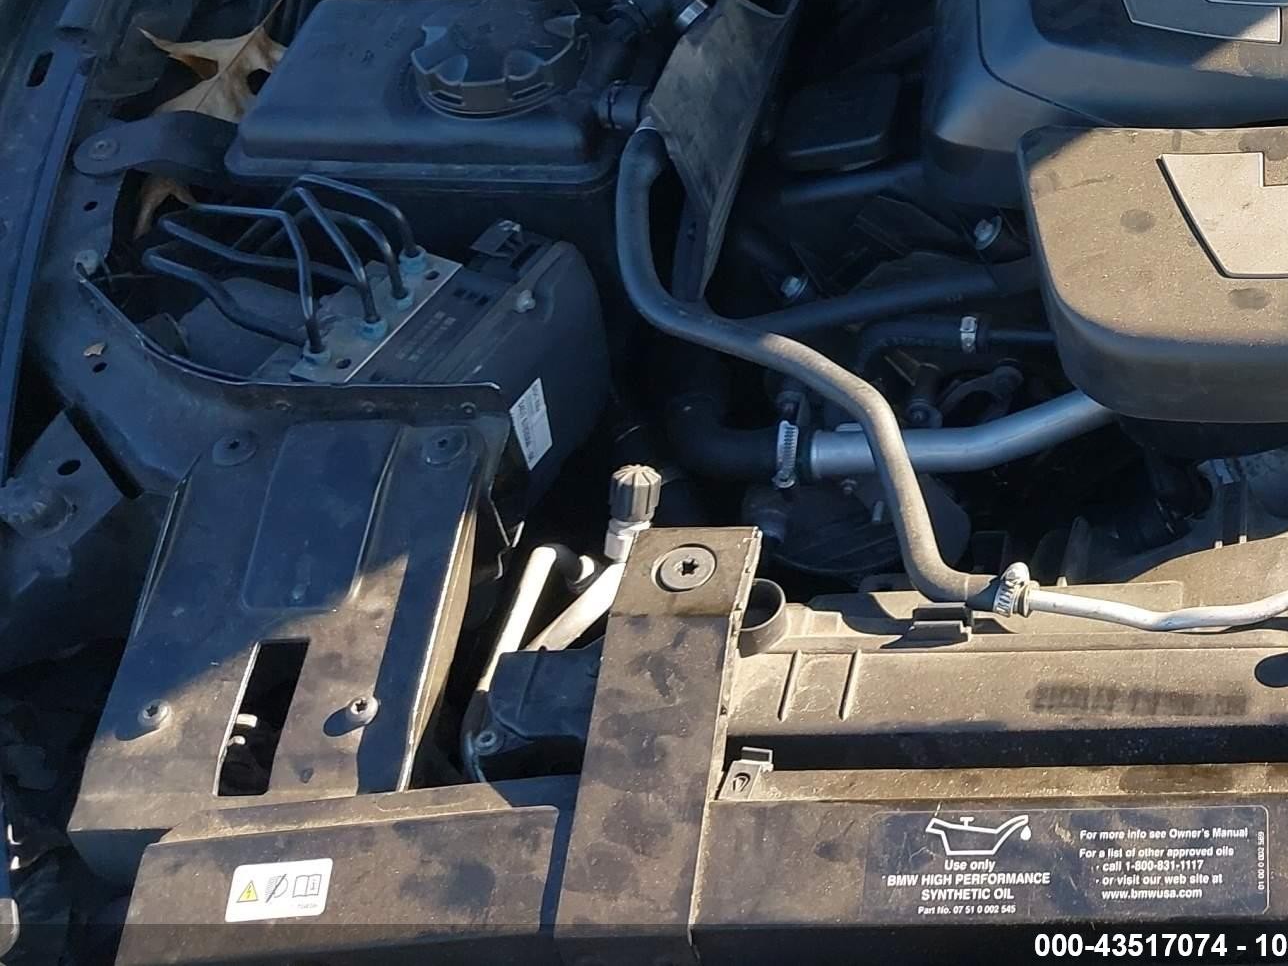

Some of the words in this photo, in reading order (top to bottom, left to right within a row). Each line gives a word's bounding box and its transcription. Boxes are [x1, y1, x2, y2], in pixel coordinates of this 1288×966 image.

[1079, 829, 1096, 840] For
[1099, 831, 1124, 840] more
[1127, 828, 1146, 839] info
[1149, 830, 1166, 839] see
[1169, 827, 1210, 839] Owner's
[1212, 827, 1248, 838] Manual
[1079, 848, 1096, 858] For
[1099, 850, 1105, 858] a
[1108, 847, 1123, 858] list
[1125, 847, 1136, 857] of
[1138, 847, 1164, 857] other
[1167, 846, 1213, 859] approved
[1216, 845, 1234, 856] oils
[944, 859, 967, 871] Use
[970, 858, 996, 872] only
[1102, 861, 1122, 872] call
[1125, 859, 1204, 871] 1-800-831-1117
[887, 874, 918, 886] BMW
[921, 874, 952, 886] HIGH
[955, 872, 1051, 885] PERFORMANCE
[1102, 876, 1113, 885] or
[1117, 874, 1140, 885] visit
[1143, 875, 1161, 885] our
[1164, 873, 1187, 884] web
[1189, 873, 1209, 884] site
[1212, 873, 1223, 884] at
[921, 888, 990, 901] SYNTHETIC
[994, 888, 1015, 900] OIL
[1102, 888, 1202, 900] www.bmwusa.com
[918, 906, 935, 915] Part
[937, 905, 951, 914] No.
[953, 905, 963, 914] 07
[965, 905, 974, 914] 51
[976, 905, 983, 914] 0
[985, 905, 999, 914] 002
